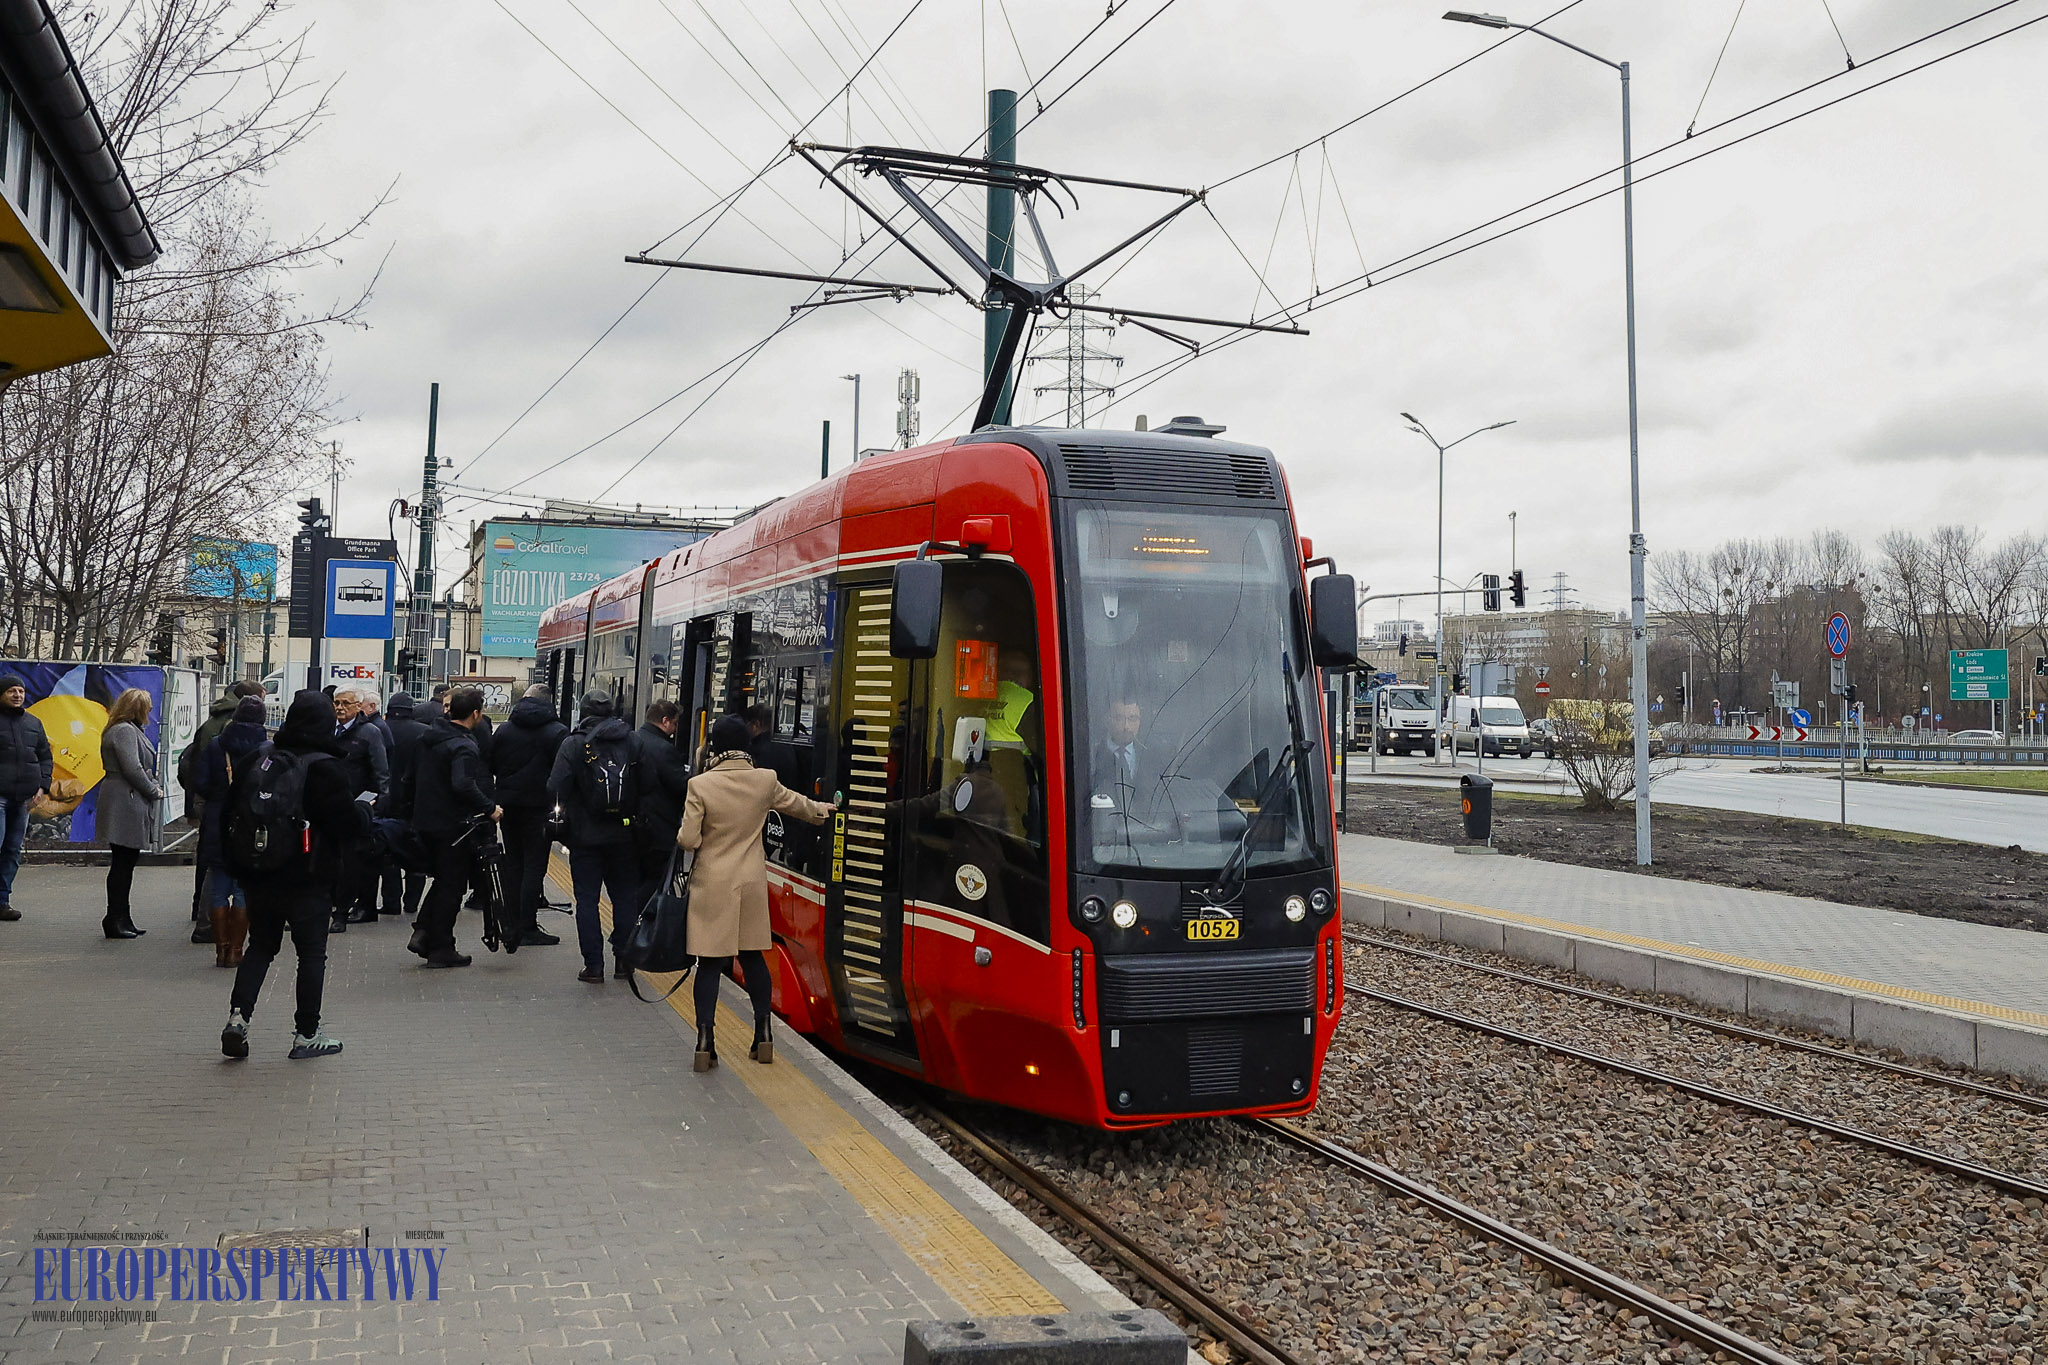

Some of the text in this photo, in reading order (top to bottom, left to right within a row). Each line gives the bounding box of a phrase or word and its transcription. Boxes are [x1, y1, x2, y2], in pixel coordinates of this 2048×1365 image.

[344, 539, 381, 547] Grundmanna
[493, 569, 601, 606] EGZOTYKA 23/24
[331, 665, 376, 679] FedEx
[767, 823, 784, 837] pesa
[1190, 921, 1236, 938] 1052
